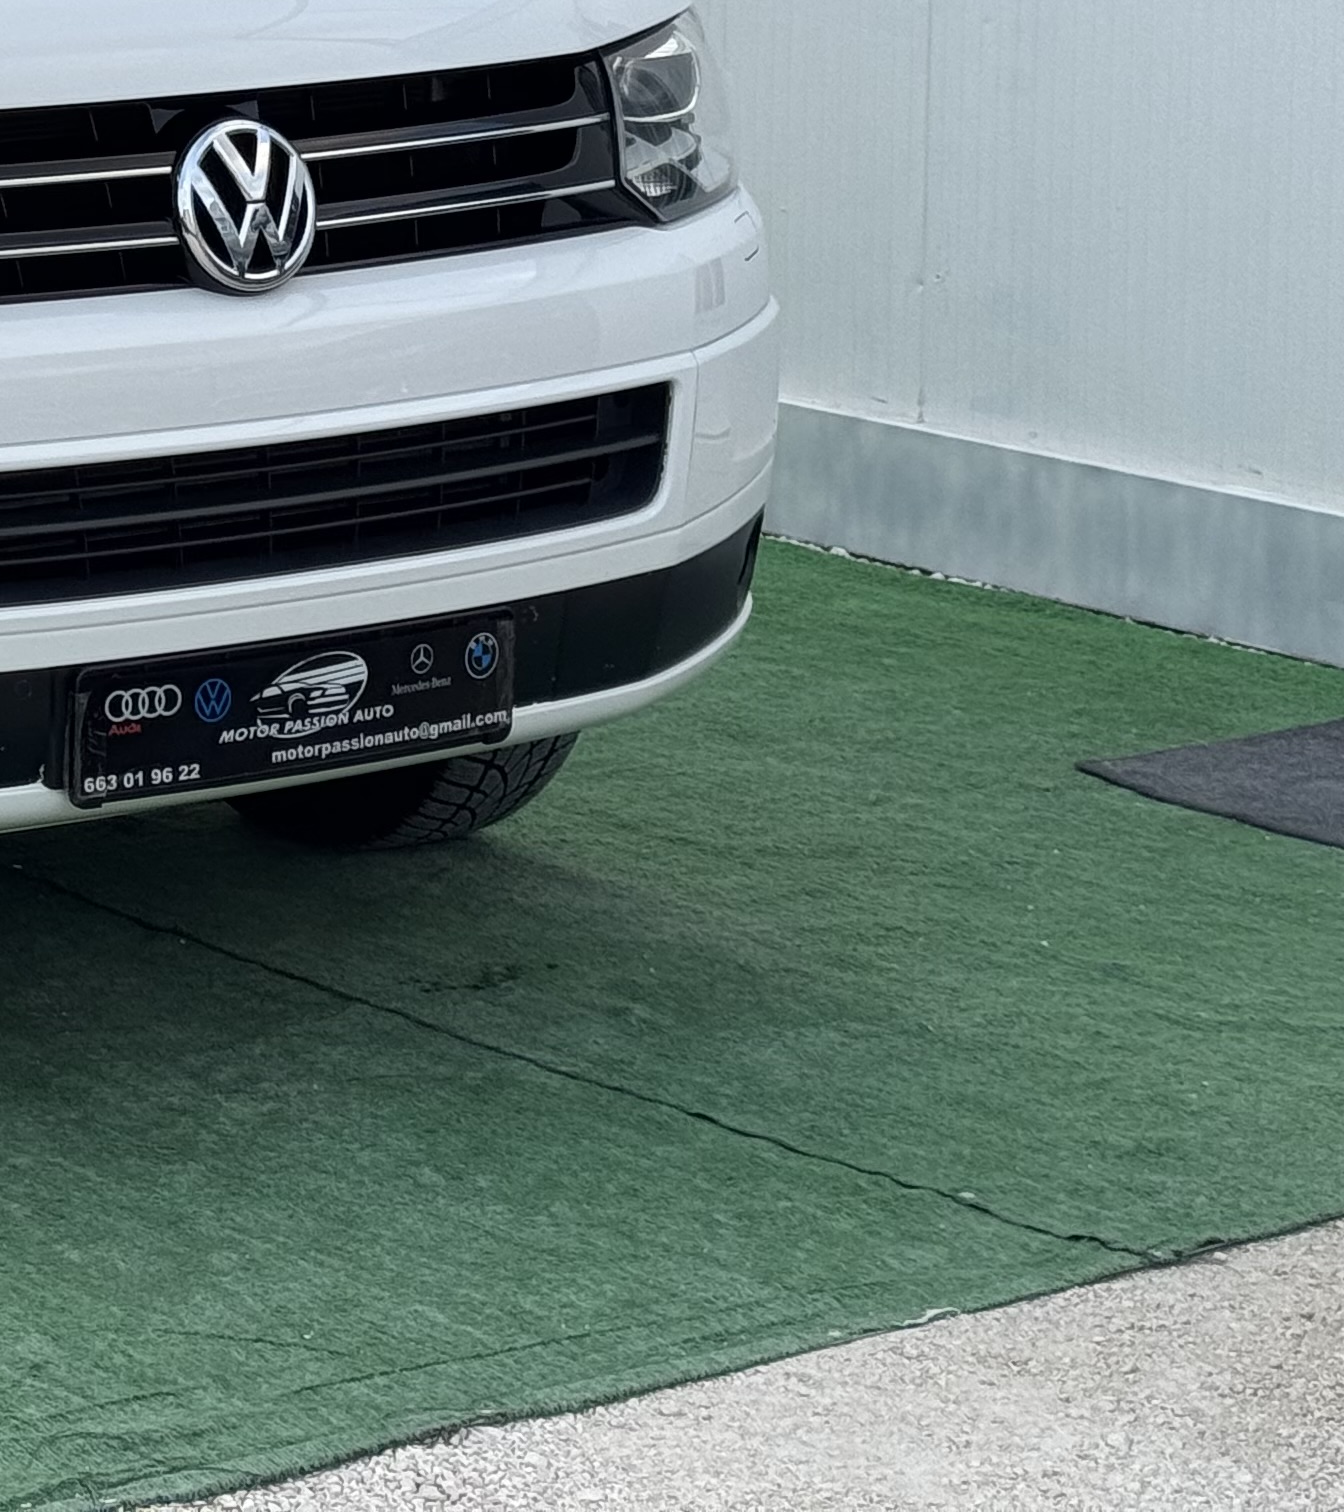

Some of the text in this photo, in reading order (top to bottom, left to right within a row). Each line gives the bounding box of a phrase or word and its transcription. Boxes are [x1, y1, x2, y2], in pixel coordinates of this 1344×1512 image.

[108, 722, 142, 736] Audi
[218, 704, 394, 744] MOTOR PASSION AUTO
[271, 710, 508, 763] motorpassionauto@gmail.com
[84, 764, 201, 793] 663 01 96 22
